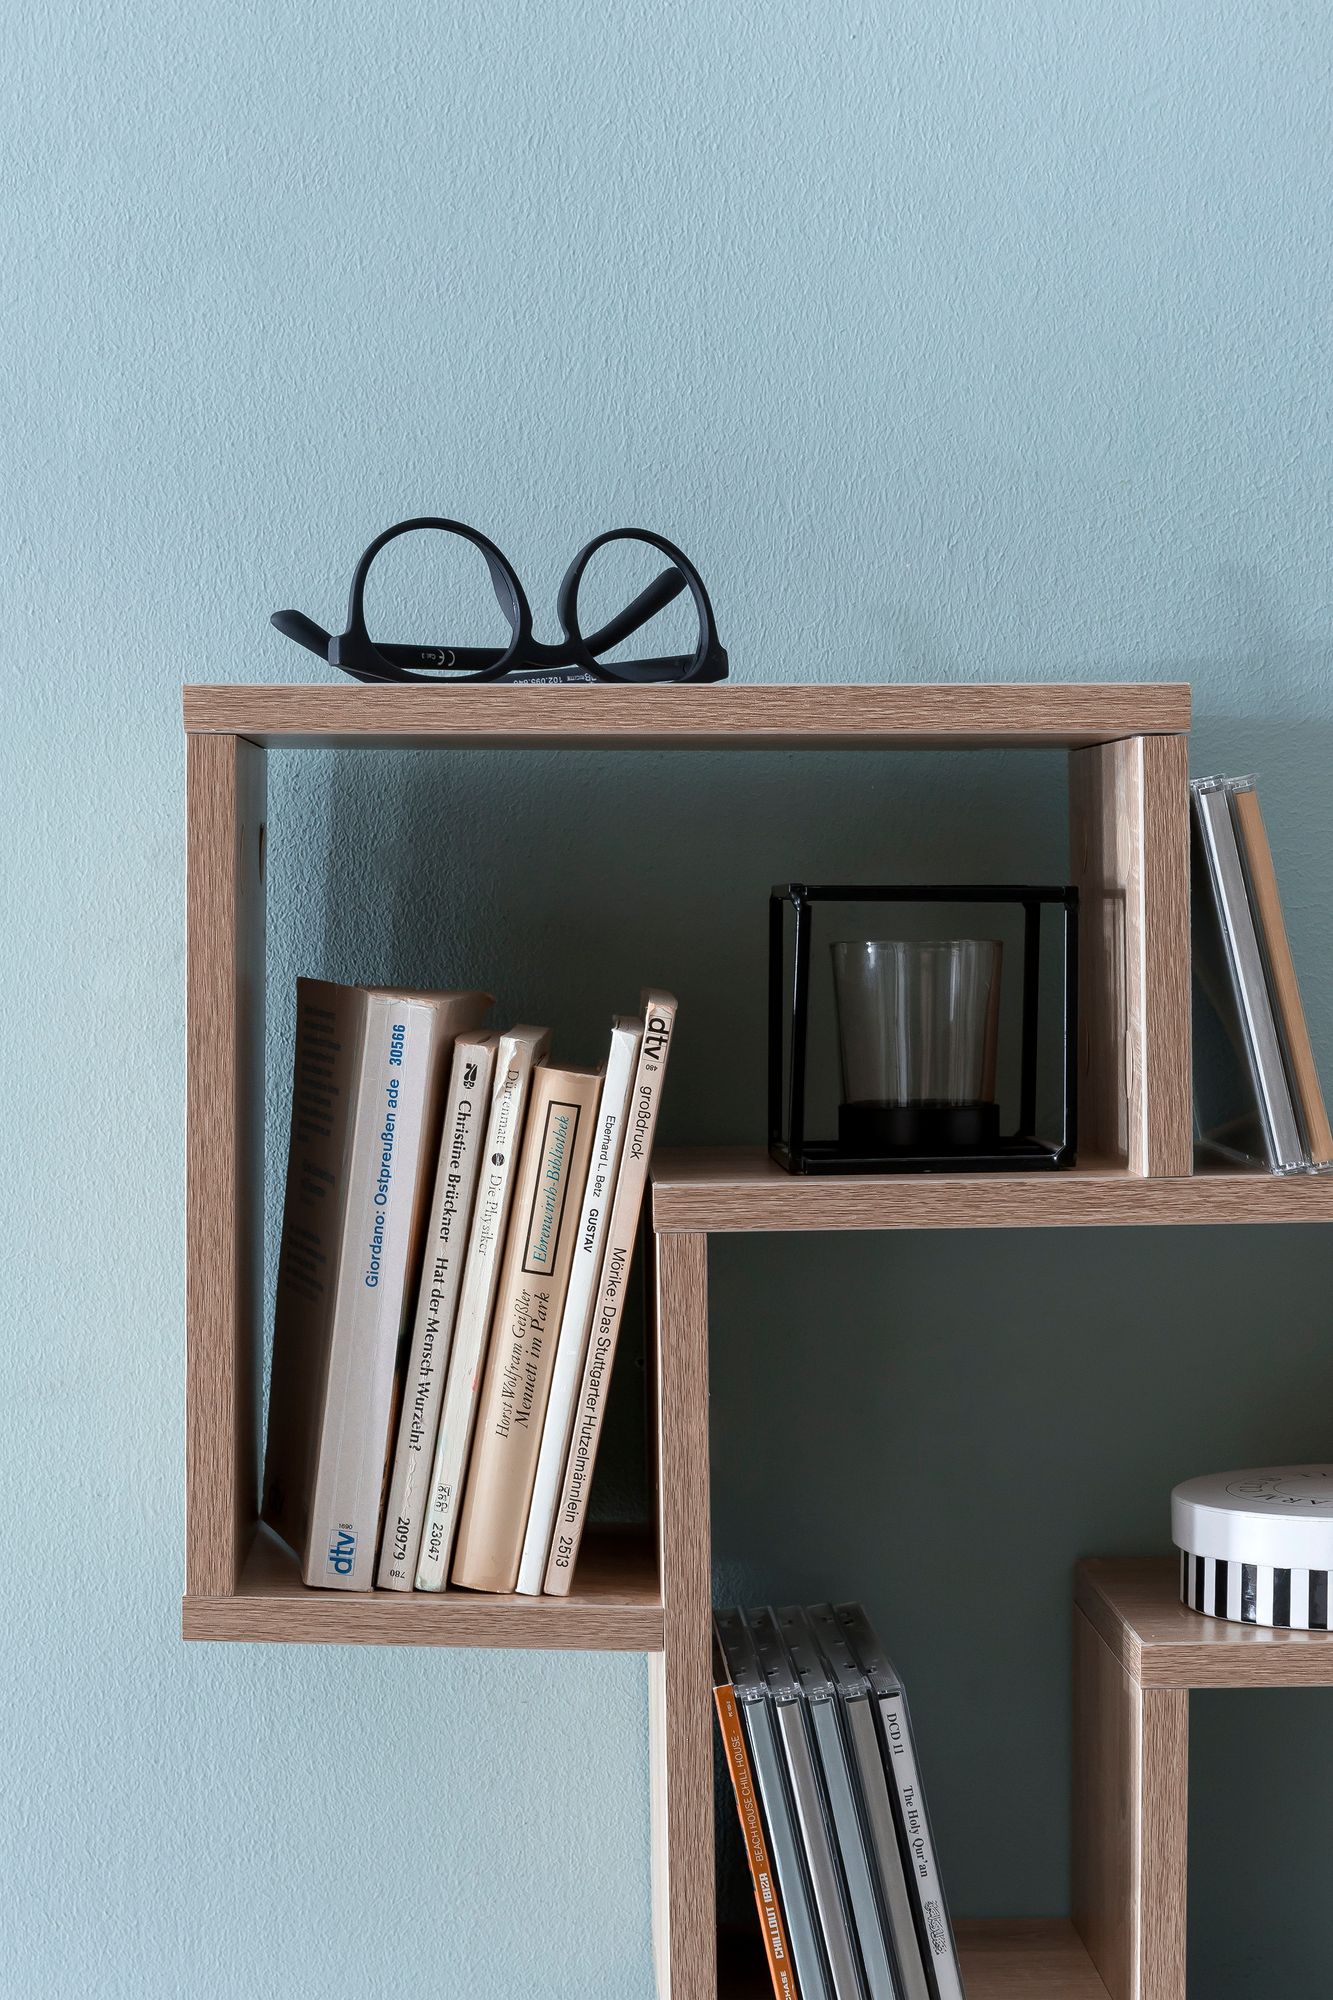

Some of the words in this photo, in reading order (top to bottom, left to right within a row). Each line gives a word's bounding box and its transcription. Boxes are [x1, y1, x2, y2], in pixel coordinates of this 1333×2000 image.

[389, 1024, 406, 1066] 30566
[644, 1016, 669, 1060] dtv
[386, 1078, 400, 1108] ade
[496, 1069, 520, 1145] Dürrenmatt
[450, 1100, 472, 1169] Christine
[599, 1115, 616, 1161] Eberhard
[630, 1086, 653, 1160] großdruck
[374, 1113, 396, 1206] Ostpreußen
[597, 1162, 608, 1172] L.
[487, 1174, 503, 1197] Die
[533, 1114, 570, 1263] Ehrenwirth-Bibliothek
[593, 1174, 606, 1198] Betz
[439, 1173, 461, 1243] Brückner
[478, 1197, 498, 1256] Physiker
[365, 1210, 386, 1288] Giordano:
[583, 1208, 599, 1253] GUSTAV
[433, 1257, 449, 1284] Hat
[605, 1247, 627, 1302] Mörike:
[429, 1290, 445, 1314] der
[512, 1289, 533, 1339] Geißler
[530, 1291, 550, 1333] Park
[599, 1306, 617, 1334] Das
[420, 1317, 440, 1376] Mensch
[525, 1337, 543, 1359] im
[501, 1343, 523, 1400] Wolfram
[585, 1336, 611, 1412] Stuttgarter
[409, 1381, 431, 1451] Wurzeln?
[514, 1363, 538, 1428] Menuett
[496, 1402, 513, 1438] Horst
[565, 1414, 597, 1523] Hutzelmännlein
[329, 1531, 354, 1575] dtv
[393, 1516, 411, 1561] 20979
[427, 1523, 445, 1563] 23047
[556, 1535, 573, 1568] 2513
[389, 1569, 406, 1579] 780
[886, 1713, 902, 1742] DCD
[730, 1735, 746, 1771] HOUSE
[893, 1743, 904, 1755] 11
[738, 1768, 751, 1796] CHILL
[903, 1785, 914, 1807] The
[743, 1797, 758, 1833] HOUSE
[907, 1809, 919, 1835] Holy
[750, 1832, 764, 1862] BEACH
[912, 1838, 928, 1878] Qur'an
[758, 1872, 773, 1903] IBIZA
[765, 1906, 784, 1959] CHILLOUT
